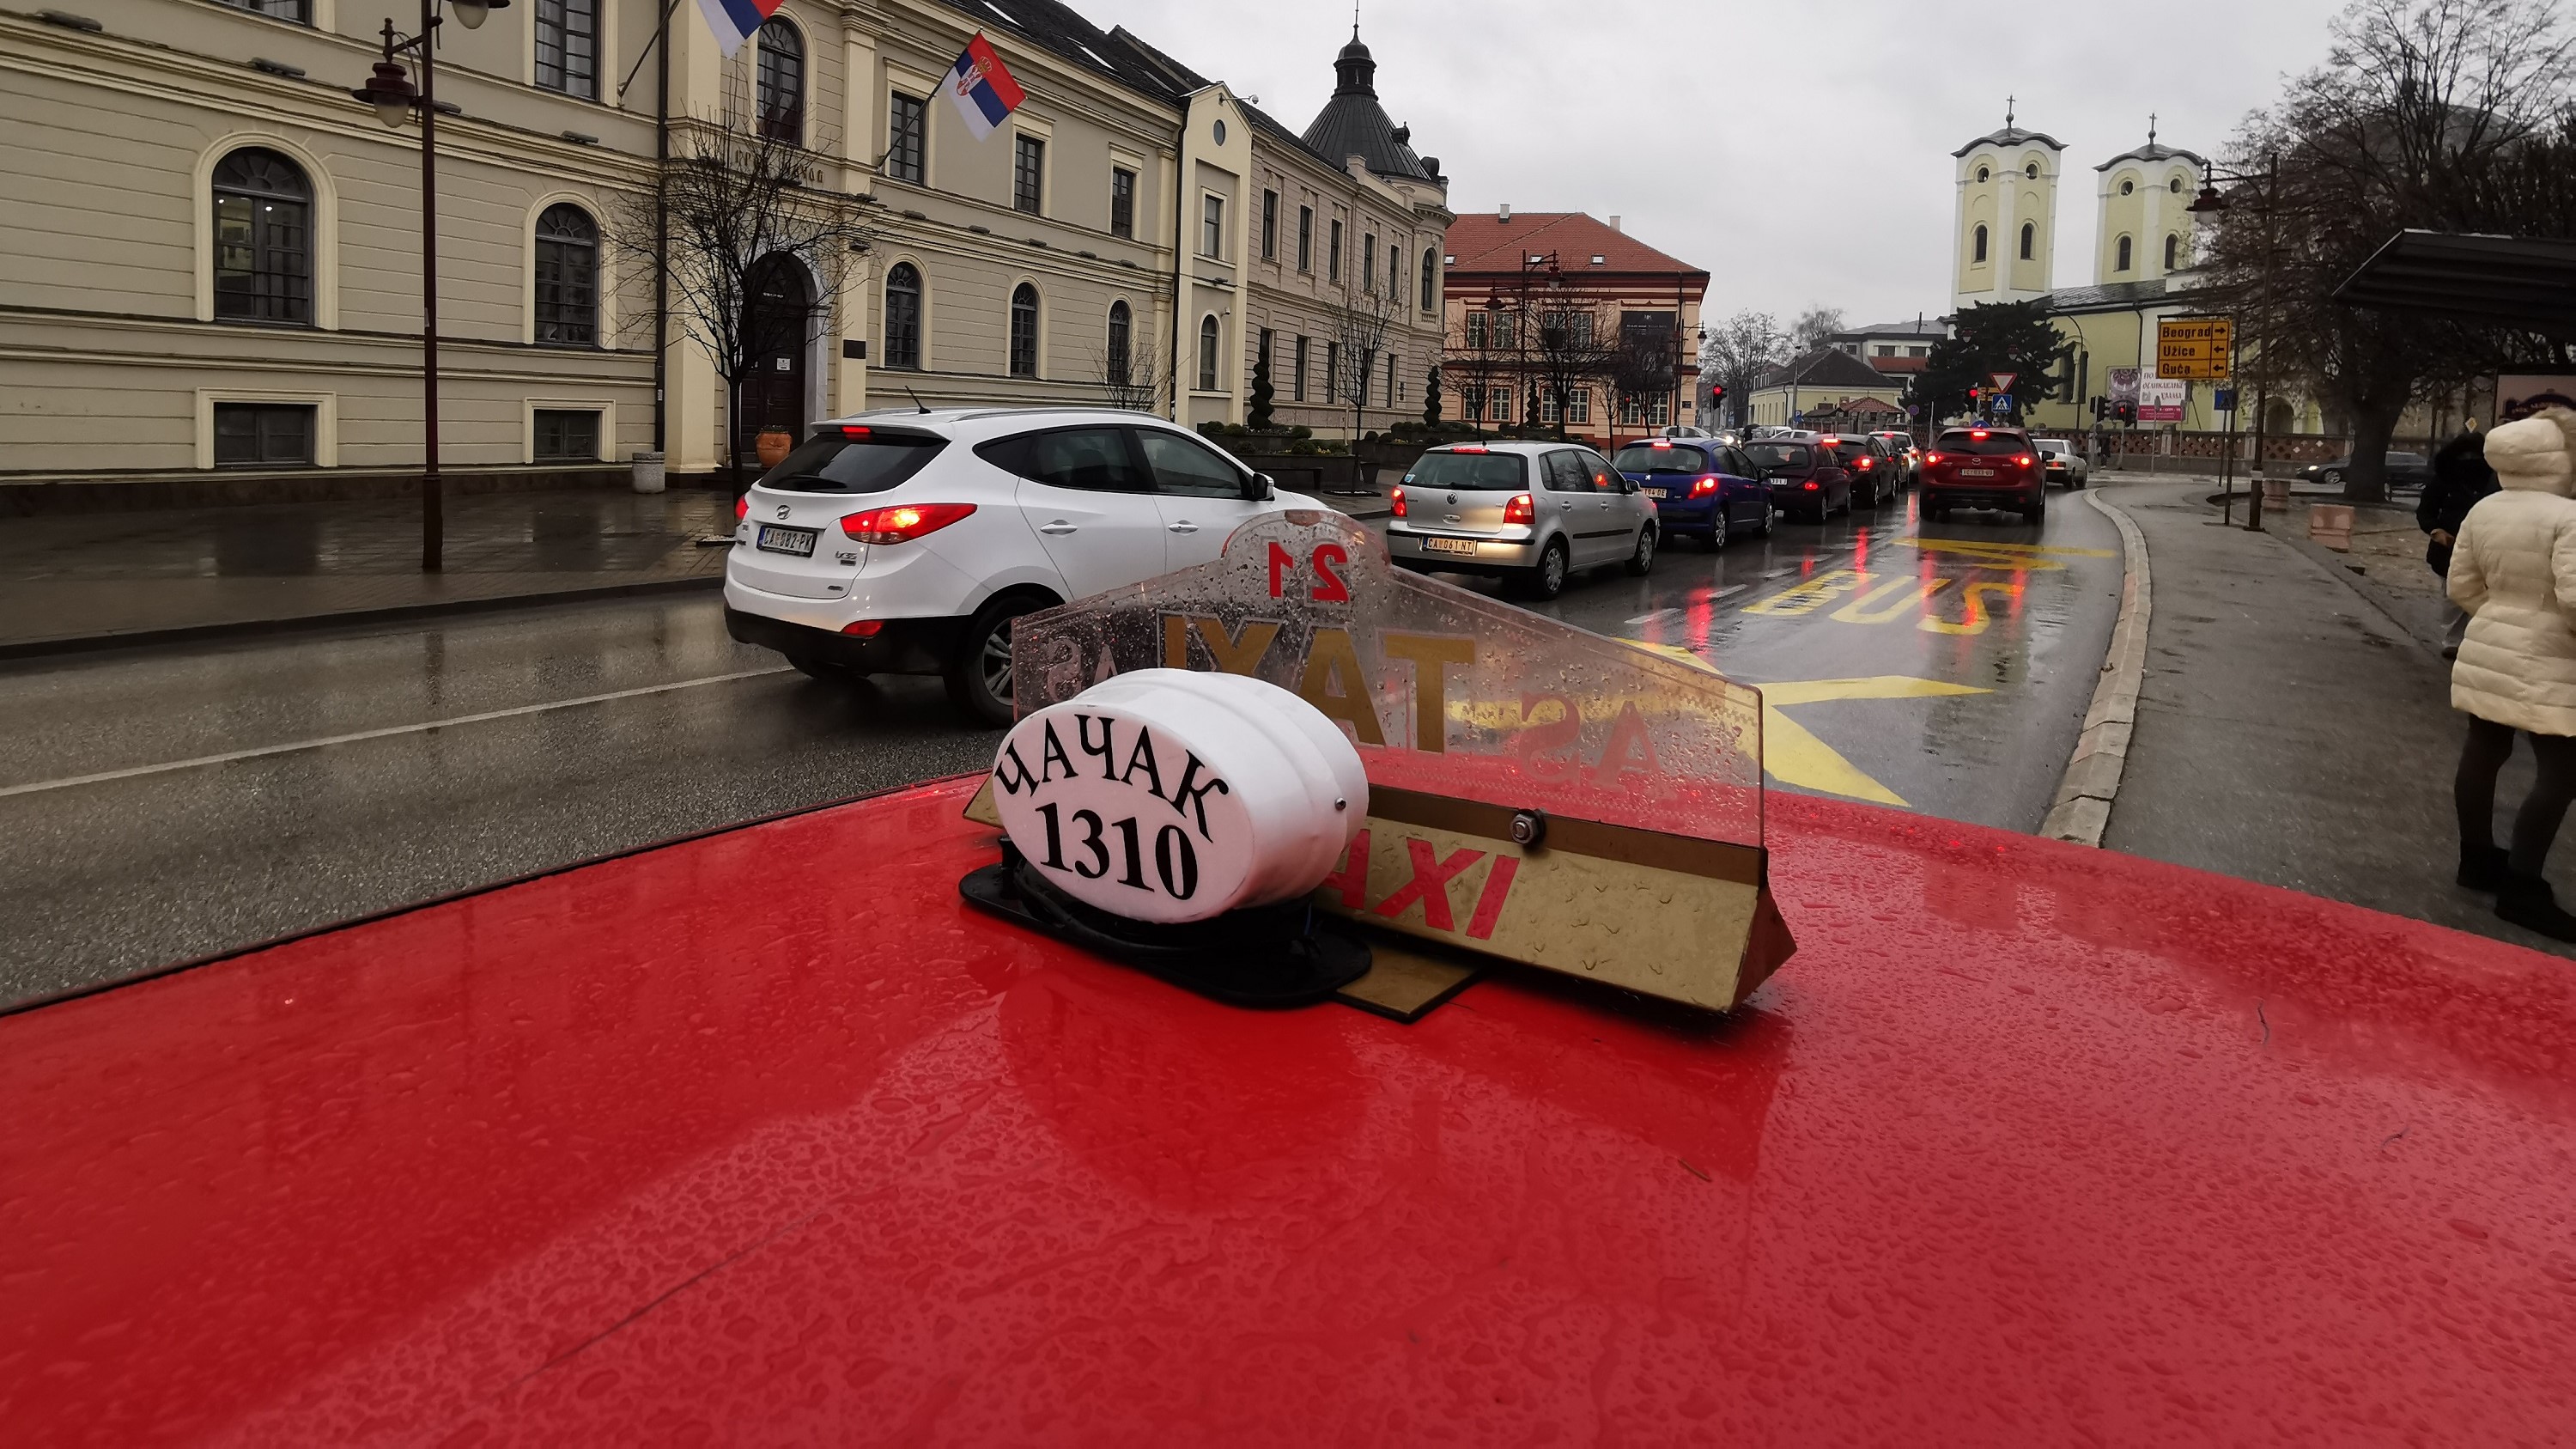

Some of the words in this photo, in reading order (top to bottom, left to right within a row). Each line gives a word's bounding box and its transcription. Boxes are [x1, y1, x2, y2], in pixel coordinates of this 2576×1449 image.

[2162, 326, 2211, 339] Beograd
[2163, 344, 2196, 356] Užice
[1740, 569, 2025, 635] BUS
[994, 714, 1229, 843] ЧАЧАК
[1035, 802, 1198, 900] 1310
[1322, 829, 1520, 941] AXI
